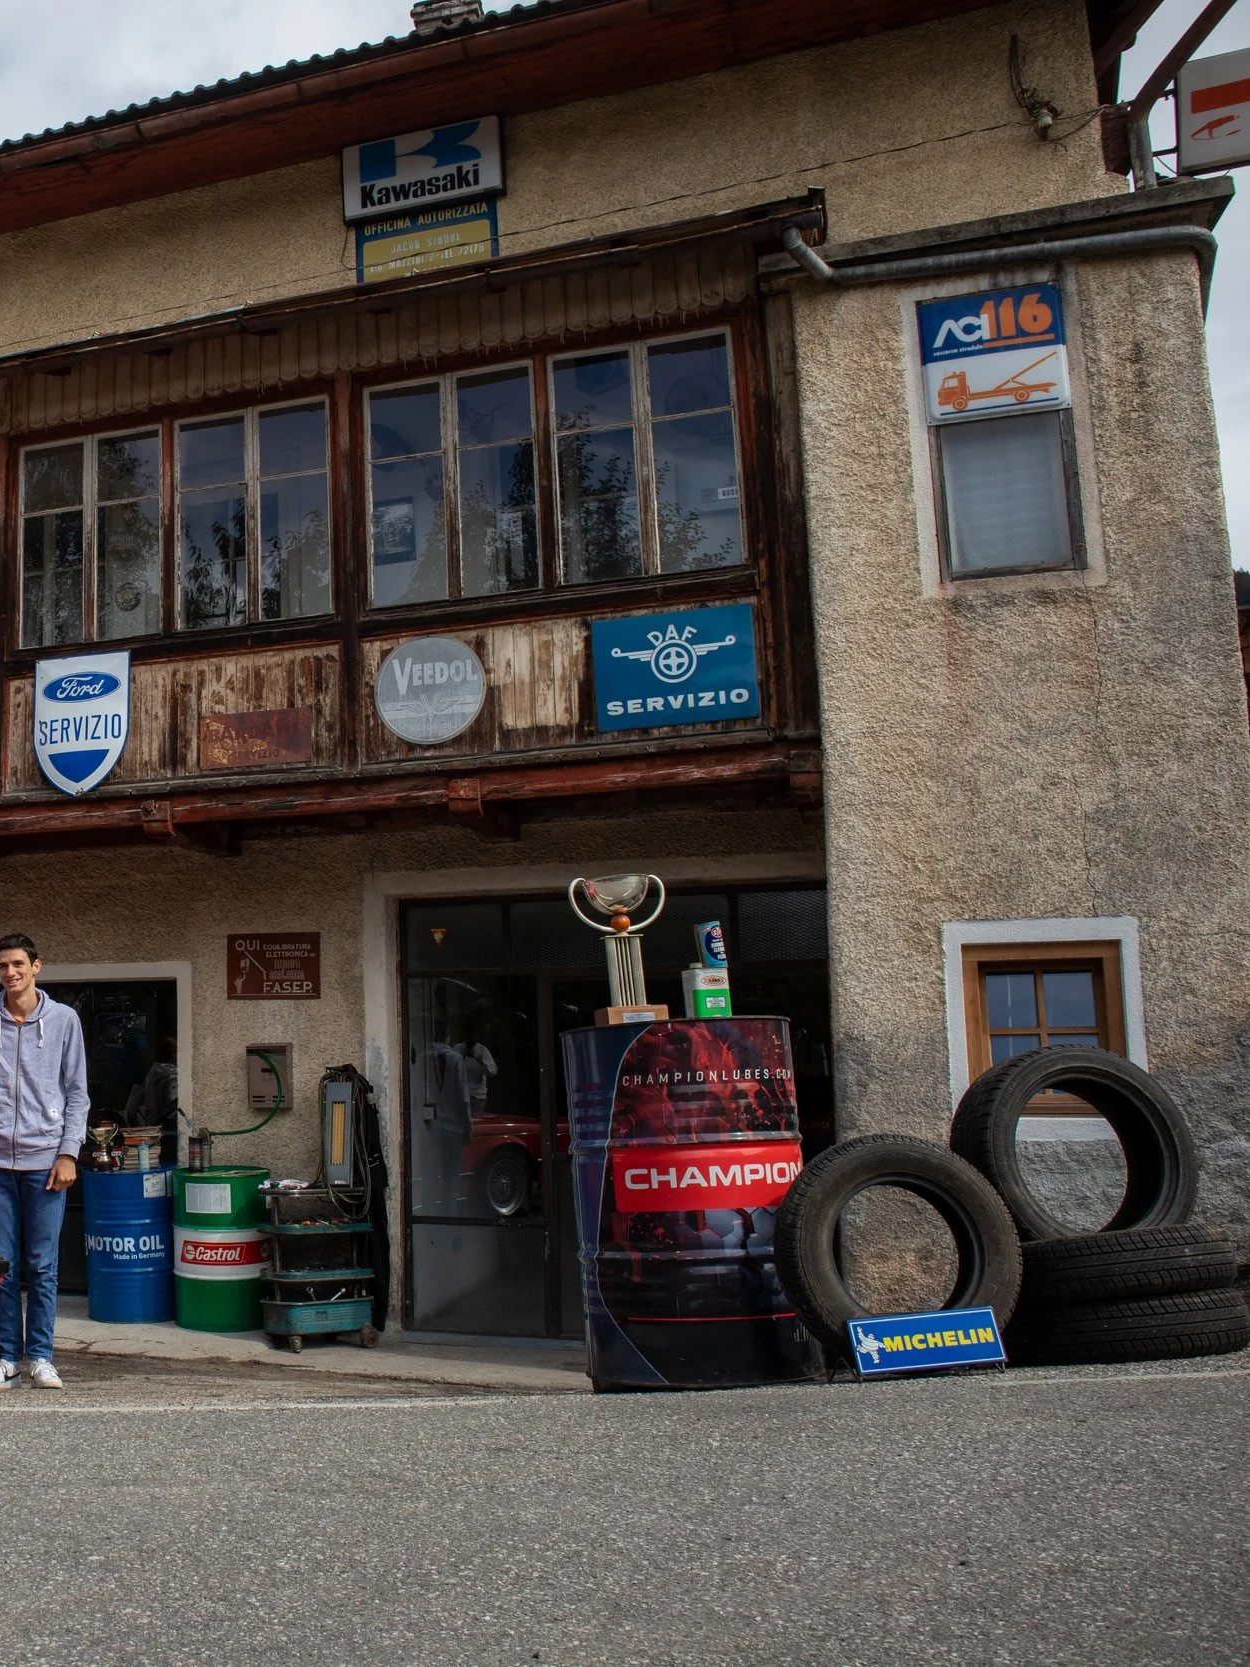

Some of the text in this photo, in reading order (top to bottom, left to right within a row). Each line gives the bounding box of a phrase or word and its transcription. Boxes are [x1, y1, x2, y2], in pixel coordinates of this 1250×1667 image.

[360, 163, 480, 209] Kawasaki
[364, 201, 488, 236] OFFICINA AUTORIZZATA
[389, 255, 424, 269] MAZZINI
[980, 293, 1053, 339] 116
[646, 624, 698, 647] DAF
[56, 676, 105, 699] Ford
[391, 657, 478, 696] VEEDOL
[606, 688, 750, 716] SERVIZIO
[39, 713, 122, 747] SERVIZIO
[235, 939, 311, 951] QUI EQUILIBRATURA
[265, 950, 308, 958] ELETTRONICA
[624, 1161, 802, 1190] CHAMPION
[87, 1234, 165, 1252] MOTOR OIL
[195, 1246, 241, 1261] Castrol
[131, 1252, 138, 1260] in
[138, 1251, 165, 1260] Germany
[882, 1327, 995, 1353] MICHELIN
